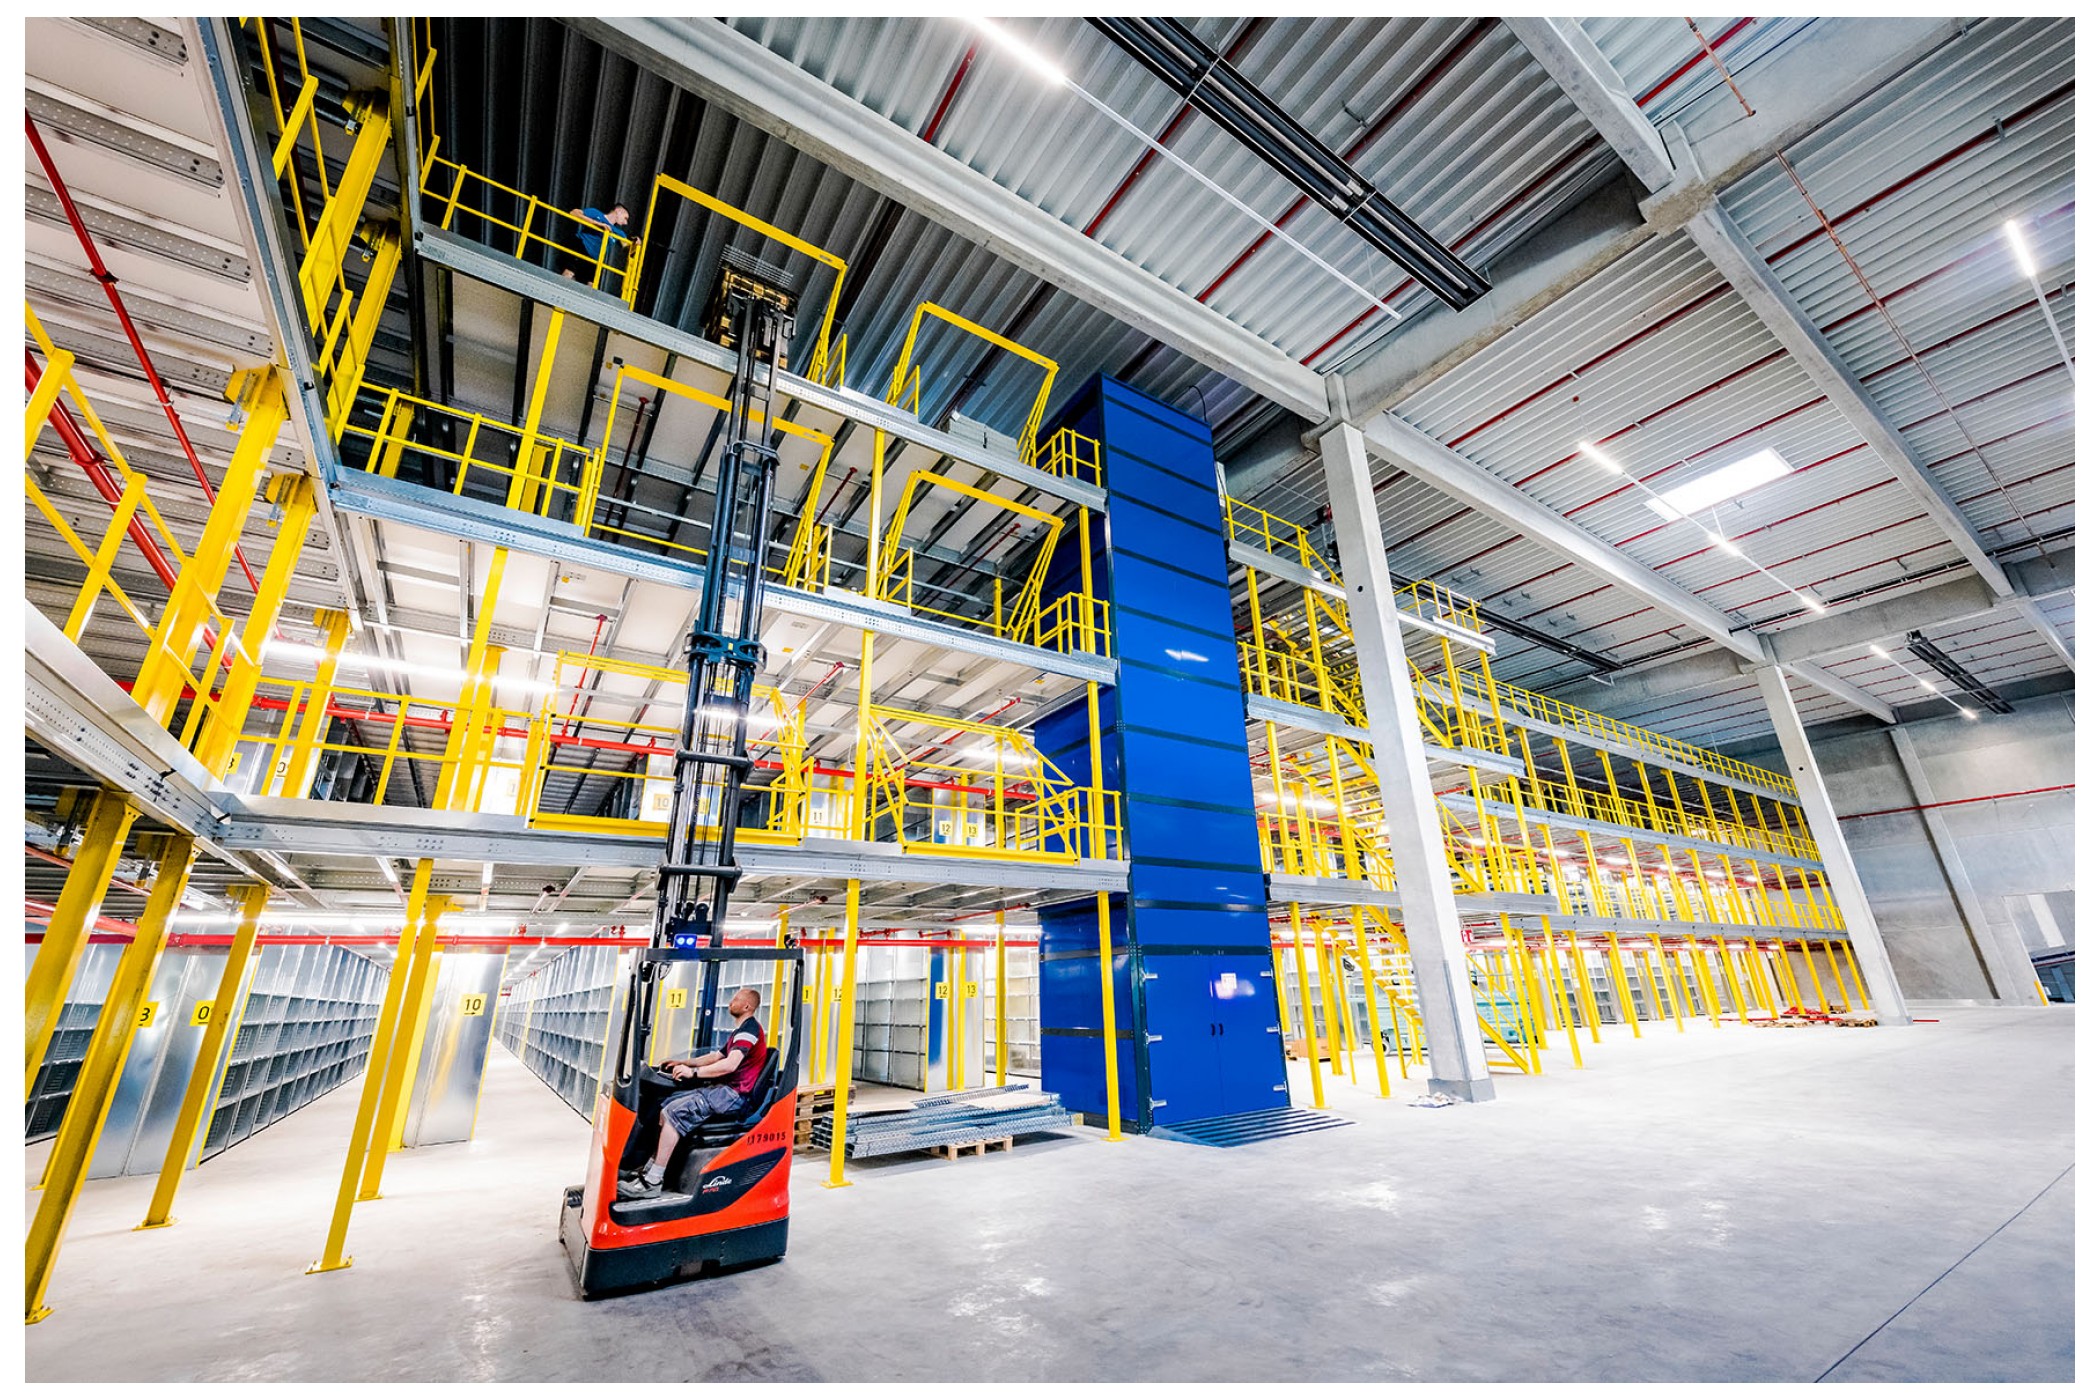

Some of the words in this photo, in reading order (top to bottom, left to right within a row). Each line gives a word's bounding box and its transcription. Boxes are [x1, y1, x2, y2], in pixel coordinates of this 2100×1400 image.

[657, 797, 669, 808] 10
[813, 811, 822, 821] 11
[941, 823, 951, 832] 12
[968, 826, 977, 835] 13
[938, 985, 948, 995] 12
[967, 984, 976, 994] 13
[670, 993, 682, 1004] 11
[465, 998, 482, 1011] 10
[702, 1175, 732, 1189] Linde
